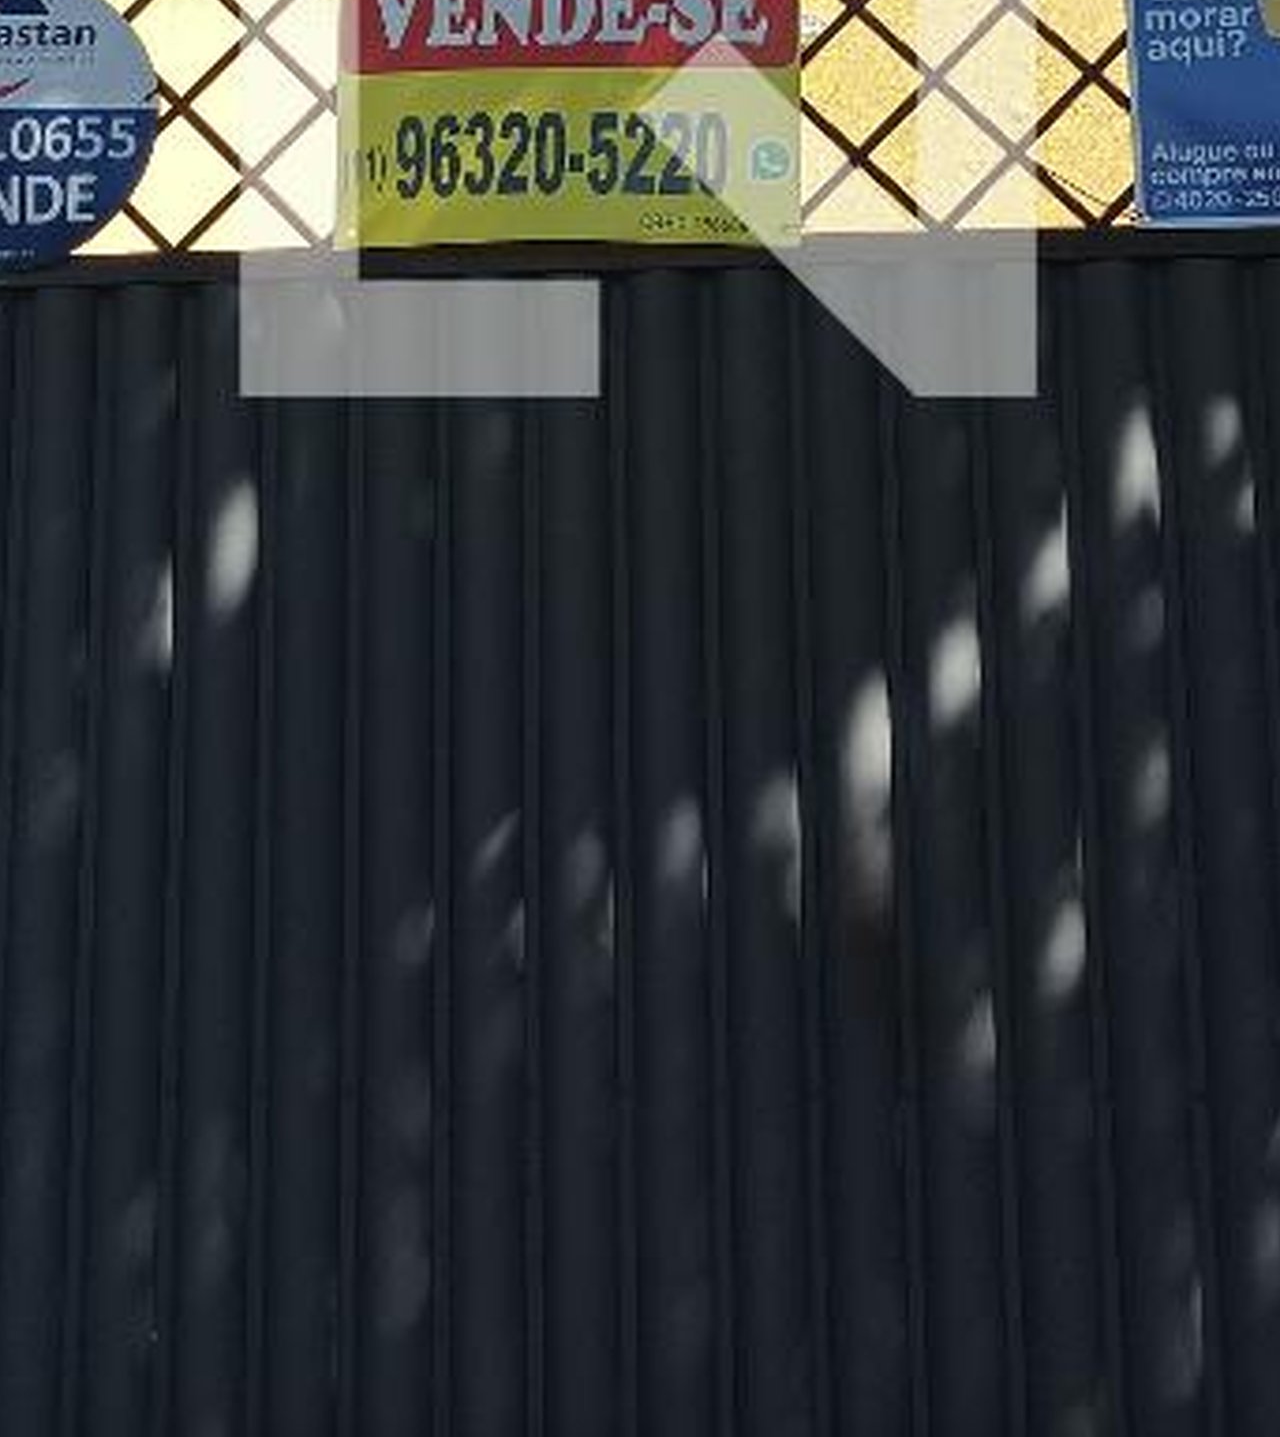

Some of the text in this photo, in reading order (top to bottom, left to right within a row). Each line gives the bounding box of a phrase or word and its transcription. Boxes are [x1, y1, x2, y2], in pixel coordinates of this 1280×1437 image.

[1145, 5, 1255, 31] morar
[1147, 29, 1247, 65] aqui?
[395, 111, 728, 200] 96320-5220
